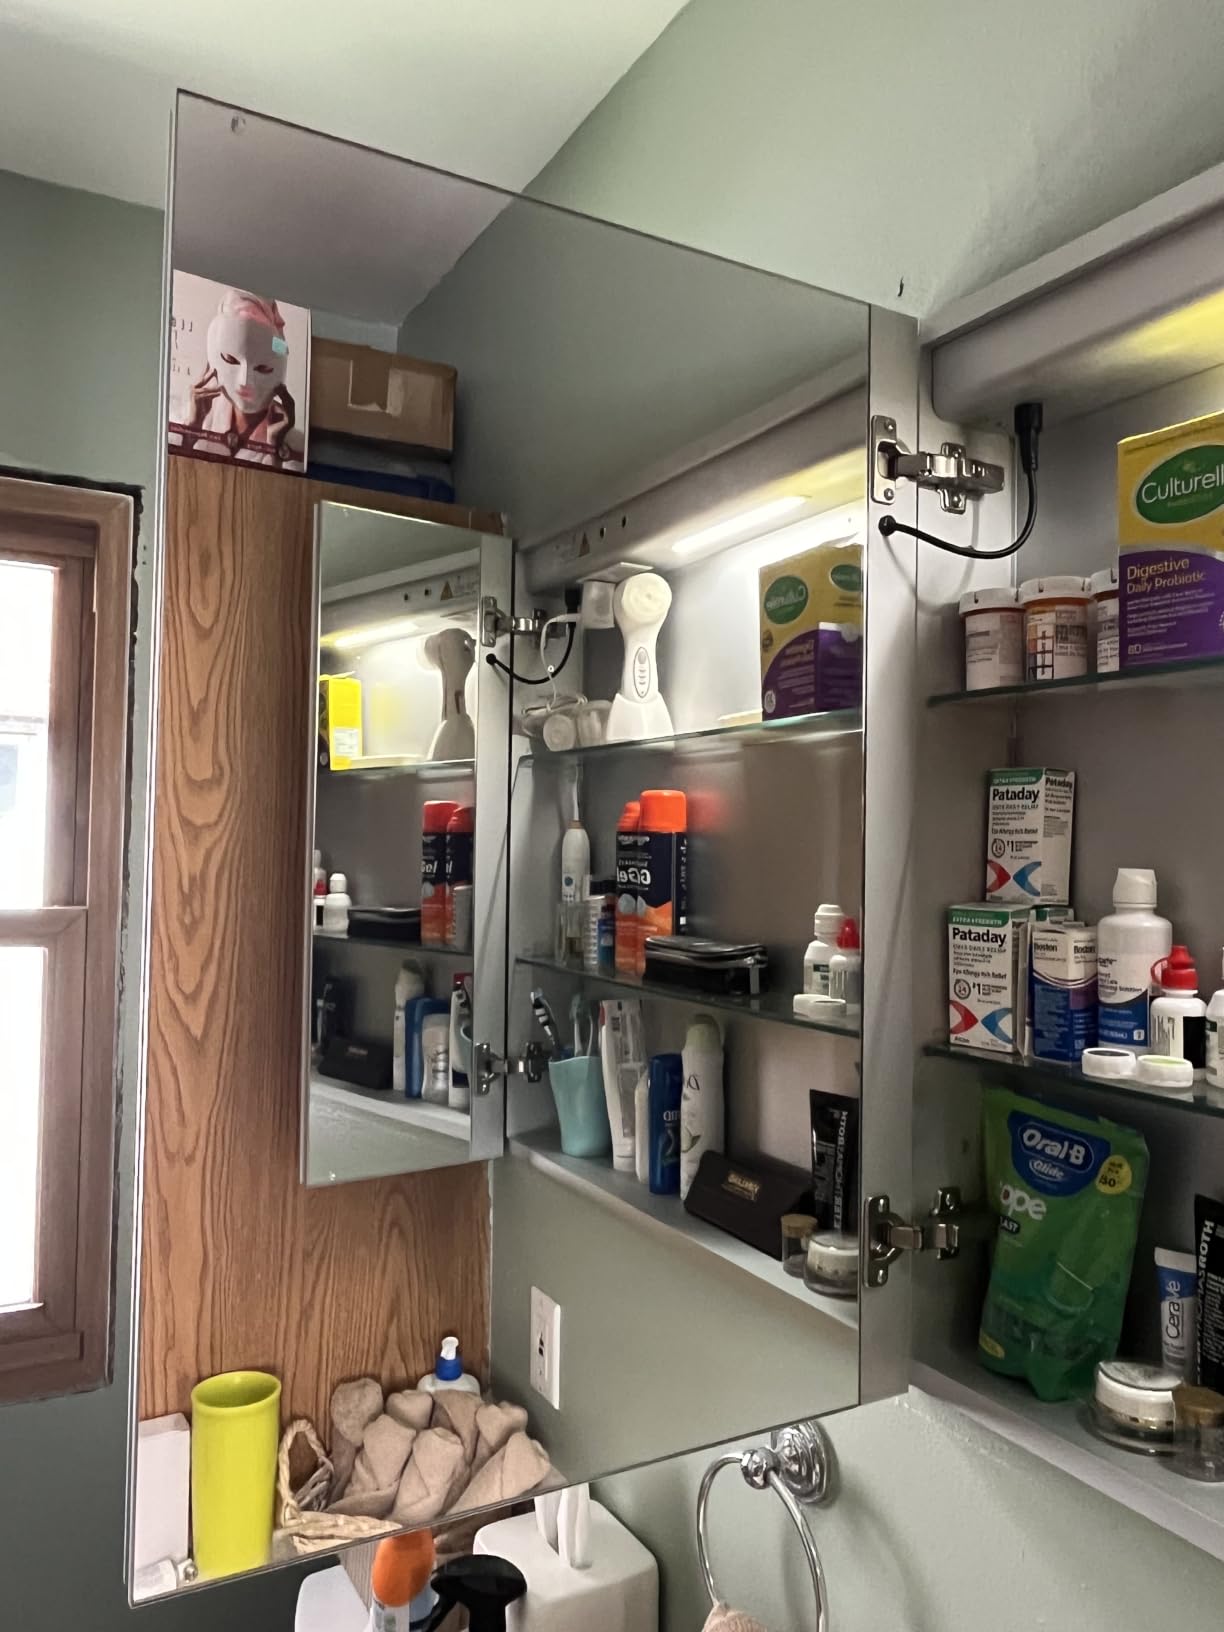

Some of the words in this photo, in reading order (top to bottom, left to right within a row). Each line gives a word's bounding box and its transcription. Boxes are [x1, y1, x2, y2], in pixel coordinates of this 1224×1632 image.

[1127, 557, 1190, 580] Digestive
[1127, 581, 1153, 594] Daily
[1155, 570, 1206, 589] Probiotic
[992, 787, 1040, 803] Pataday
[953, 927, 1007, 947] Pataday
[1034, 943, 1058, 952] Boston
[1023, 1129, 1086, 1165] Oral-B
[1034, 1159, 1065, 1178] Glide
[1000, 1183, 1047, 1220] ope
[1199, 1220, 1215, 1269] ROTH
[1166, 1280, 1181, 1339] CeraVe
